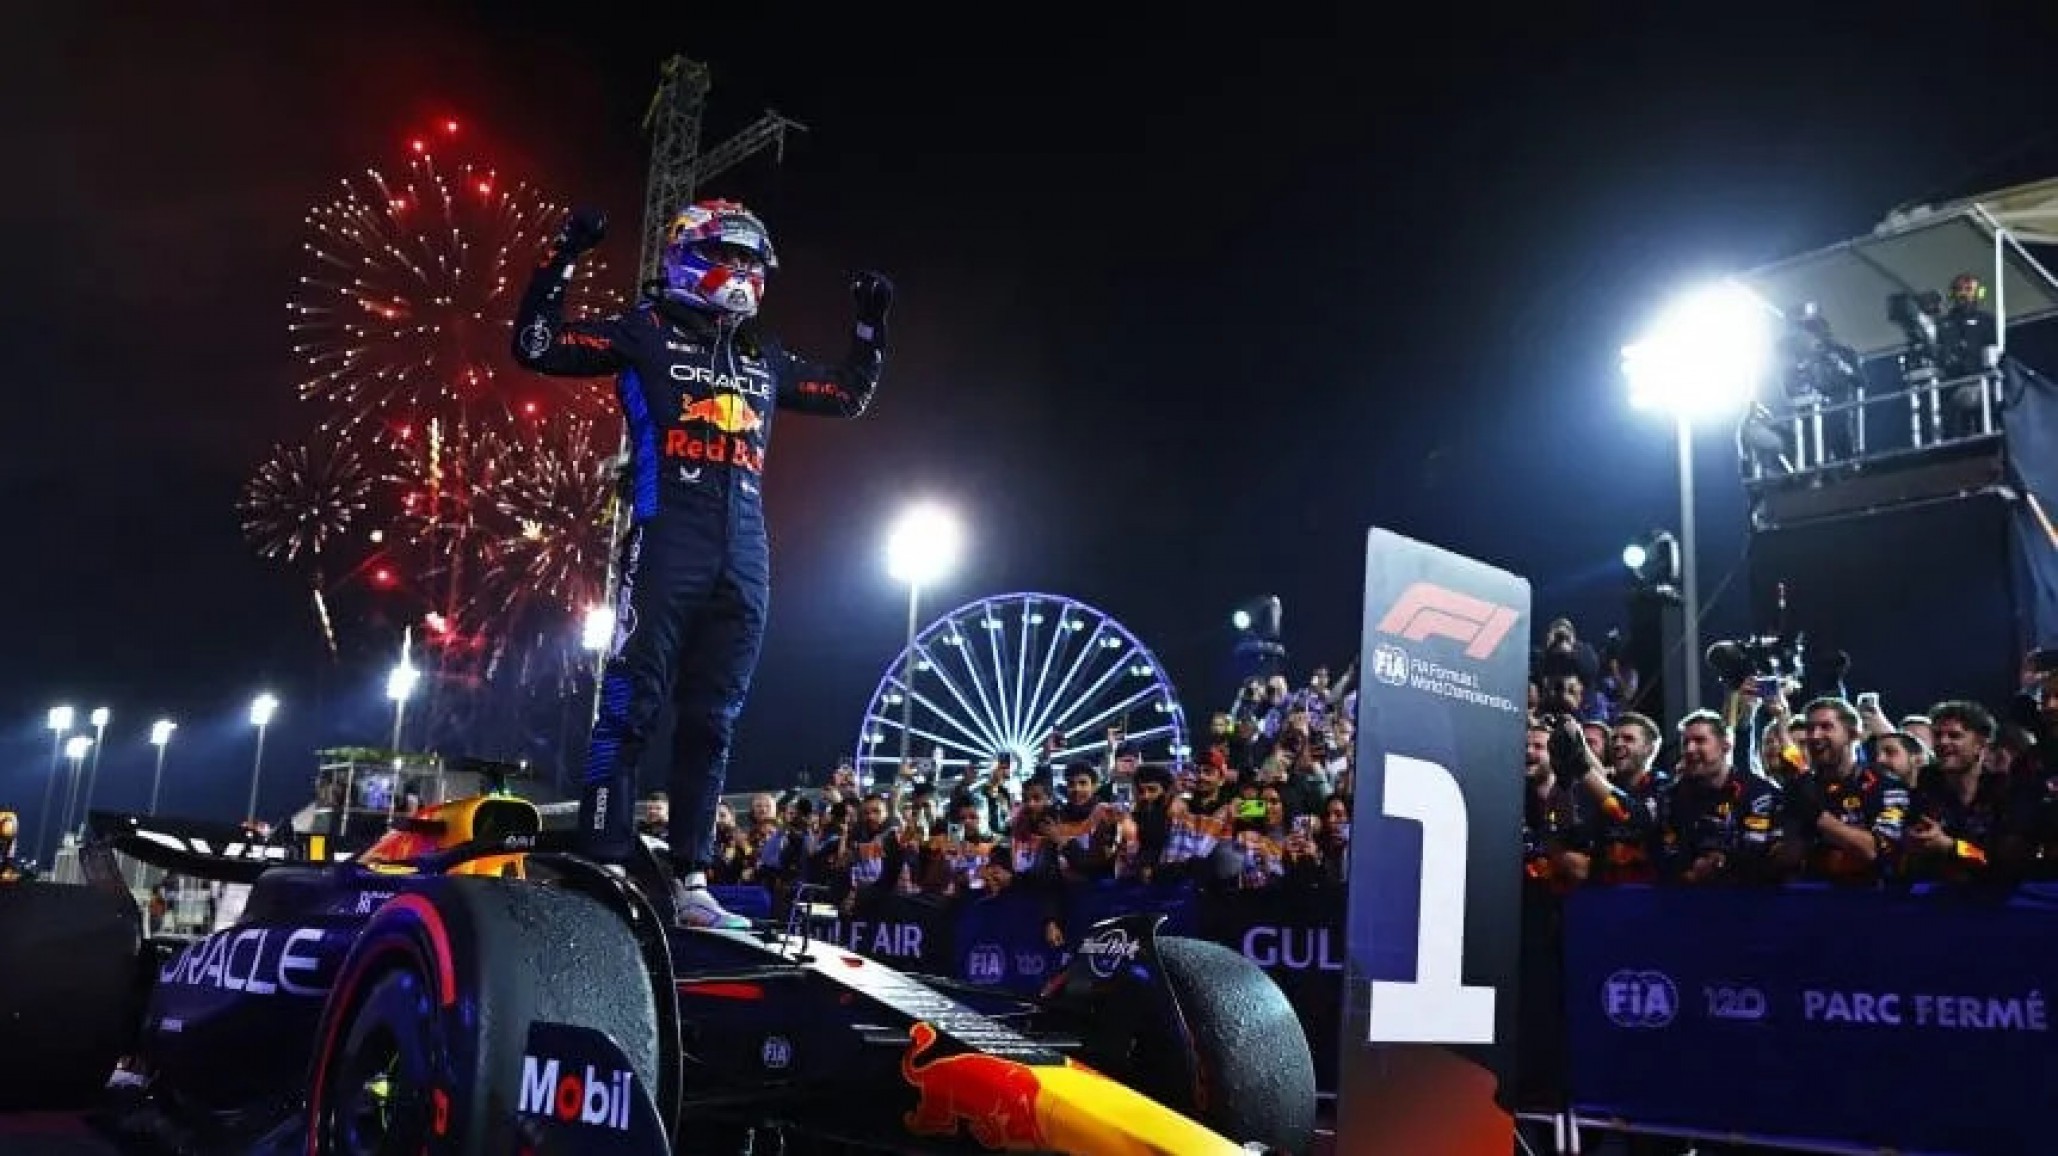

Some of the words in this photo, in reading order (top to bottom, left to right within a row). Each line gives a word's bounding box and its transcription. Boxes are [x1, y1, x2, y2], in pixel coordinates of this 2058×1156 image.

[671, 365, 771, 399] ORACLE
[666, 429, 726, 462] Red
[1376, 582, 1519, 660] F1
[1370, 754, 1496, 1044] 1
[873, 921, 922, 958] AIR
[970, 952, 1000, 976] FIA
[1608, 982, 1671, 1015] FIA
[1803, 990, 1901, 1024] PARC
[1913, 989, 2048, 1030] FERMÉ
[518, 1055, 632, 1130] Mobil
